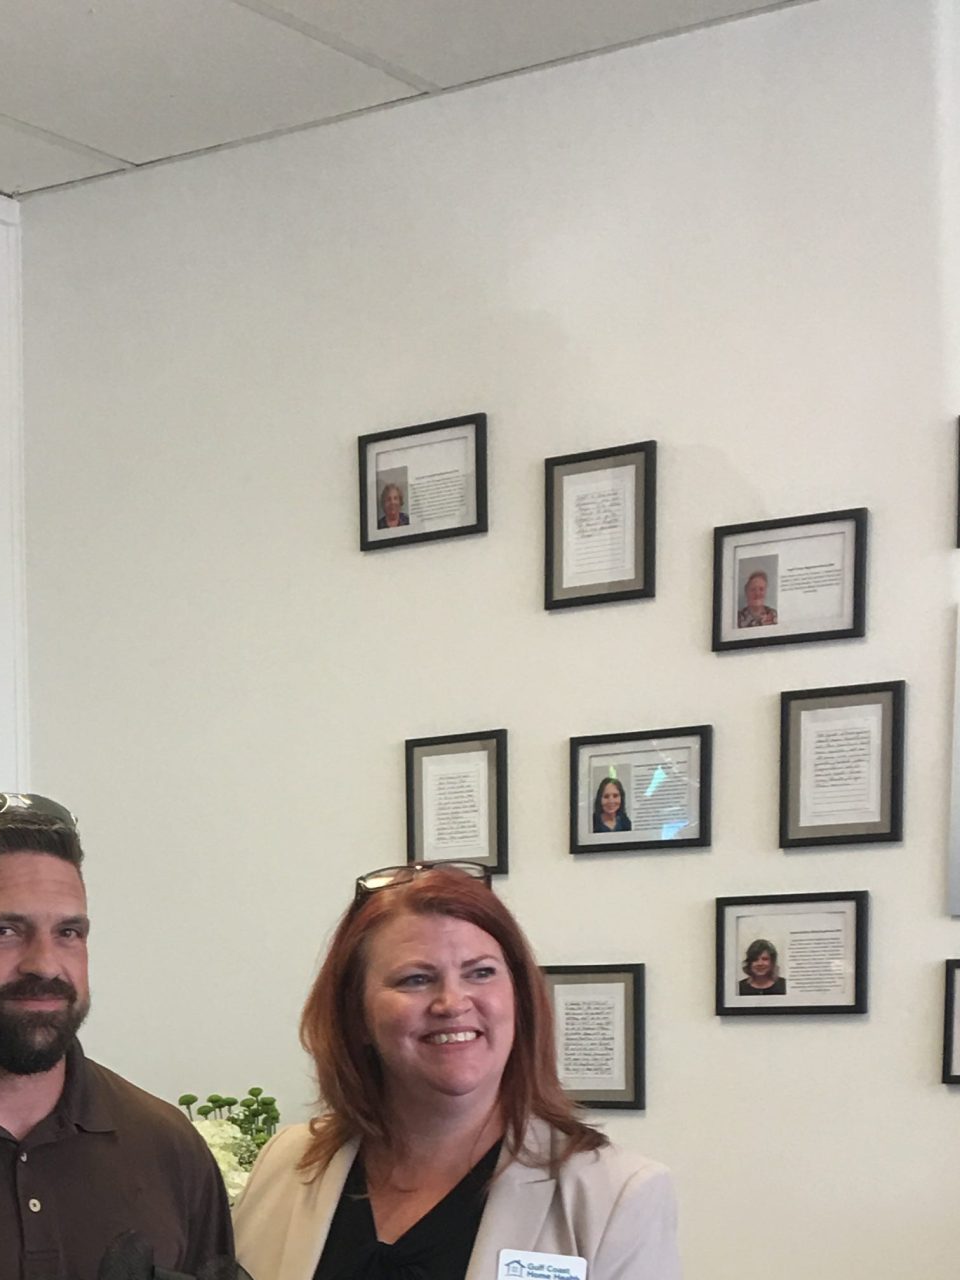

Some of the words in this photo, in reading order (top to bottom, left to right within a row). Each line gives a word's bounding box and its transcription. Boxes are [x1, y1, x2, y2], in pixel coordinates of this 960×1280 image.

[527, 1262, 545, 1271] Gulf
[546, 1265, 570, 1274] Coast
[526, 1271, 551, 1280] Home
